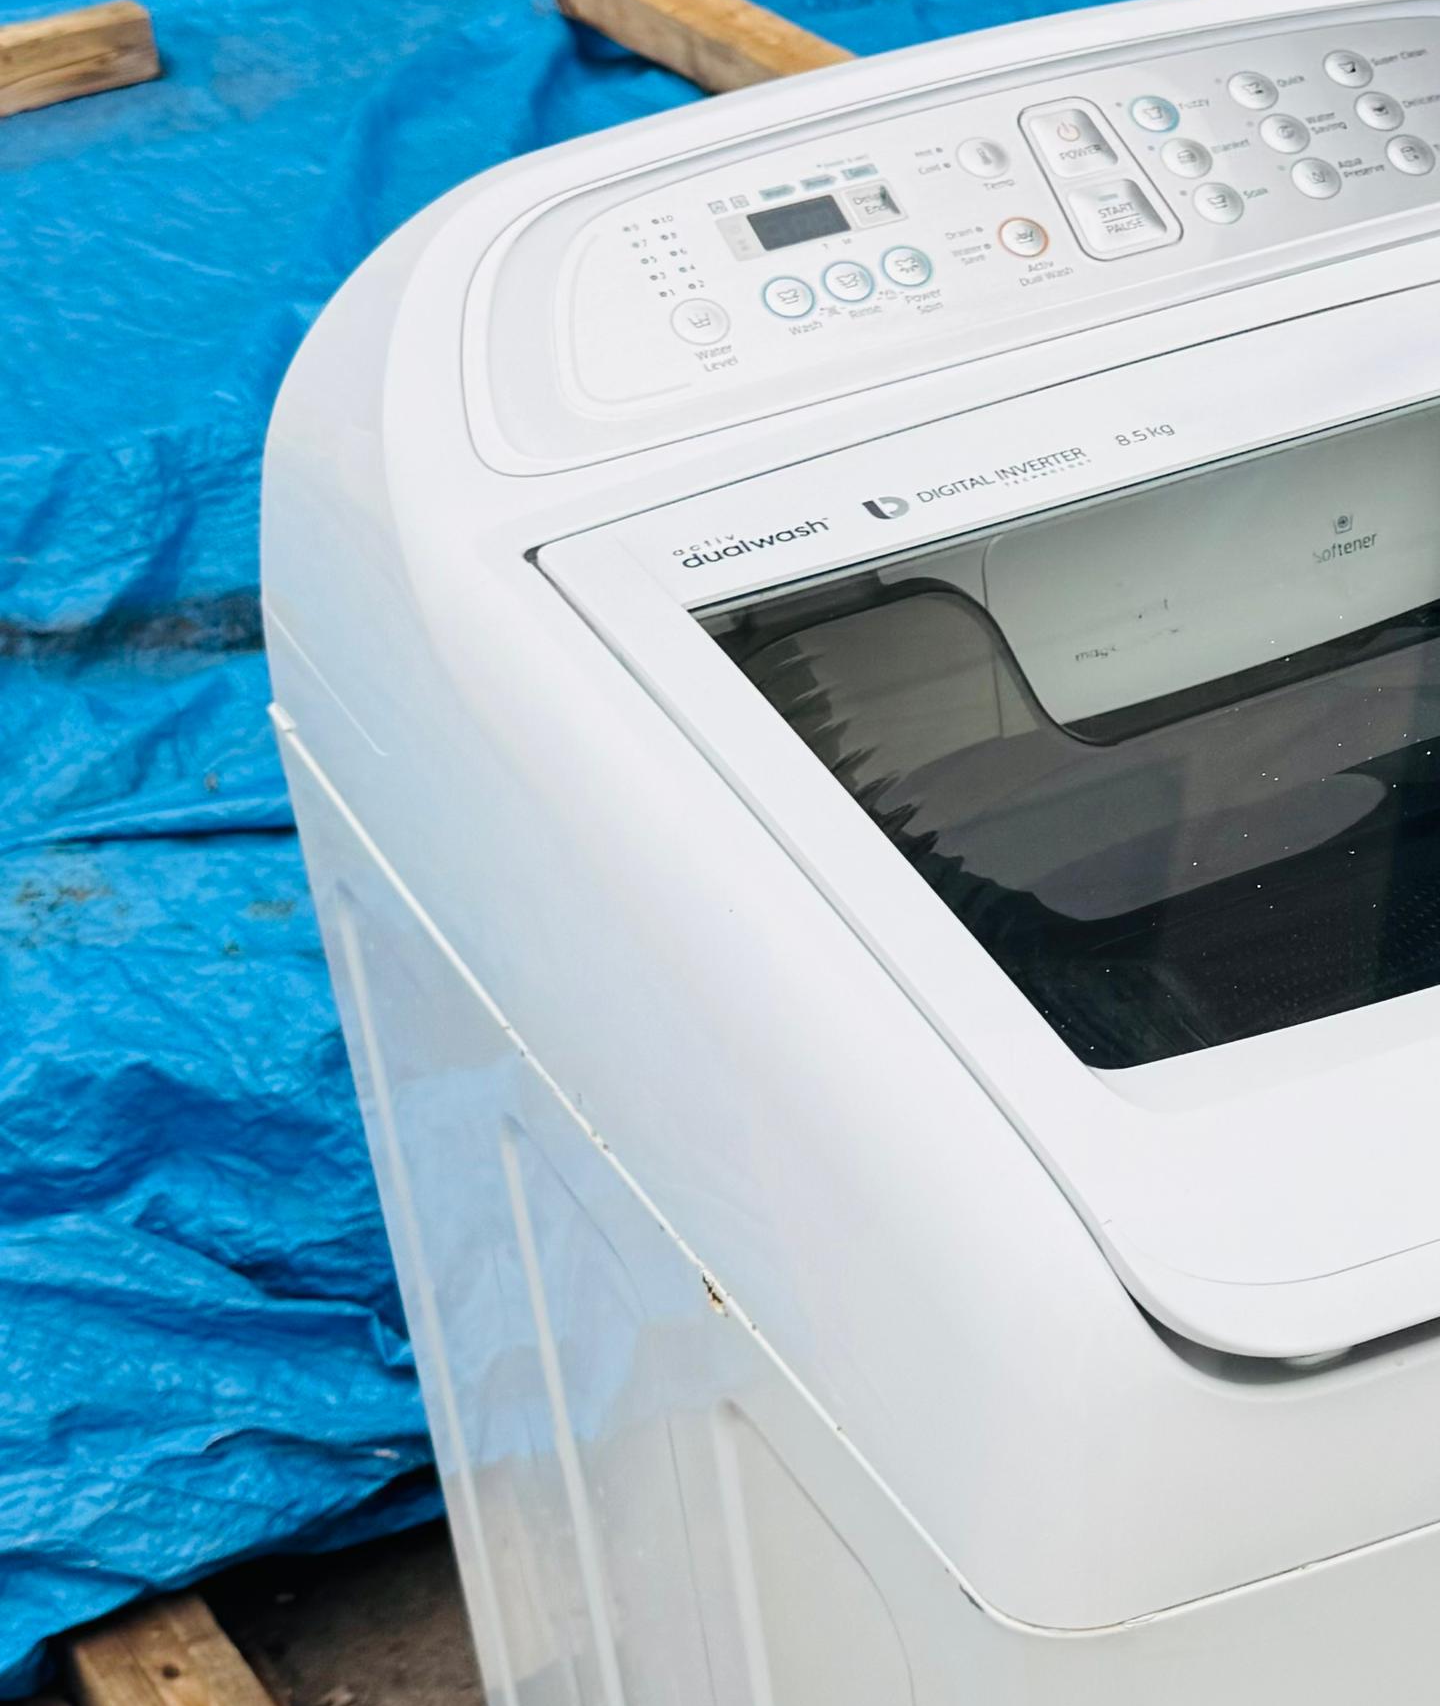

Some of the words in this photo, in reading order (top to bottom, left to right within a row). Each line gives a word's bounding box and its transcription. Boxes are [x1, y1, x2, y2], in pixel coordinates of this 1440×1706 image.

[1371, 54, 1398, 66] Super
[1400, 49, 1427, 60] Clean
[1276, 75, 1305, 88] Quick
[1059, 144, 1101, 160] POWER
[1098, 202, 1134, 219] START
[1106, 219, 1145, 234] PAUSE
[788, 320, 823, 336] Wash
[703, 355, 738, 373] Level
[915, 474, 996, 503] DIGITAL
[993, 447, 1087, 482] INVERTER
[672, 534, 735, 557] activ
[682, 520, 829, 569] dualwash
[1312, 531, 1378, 564] Softener
